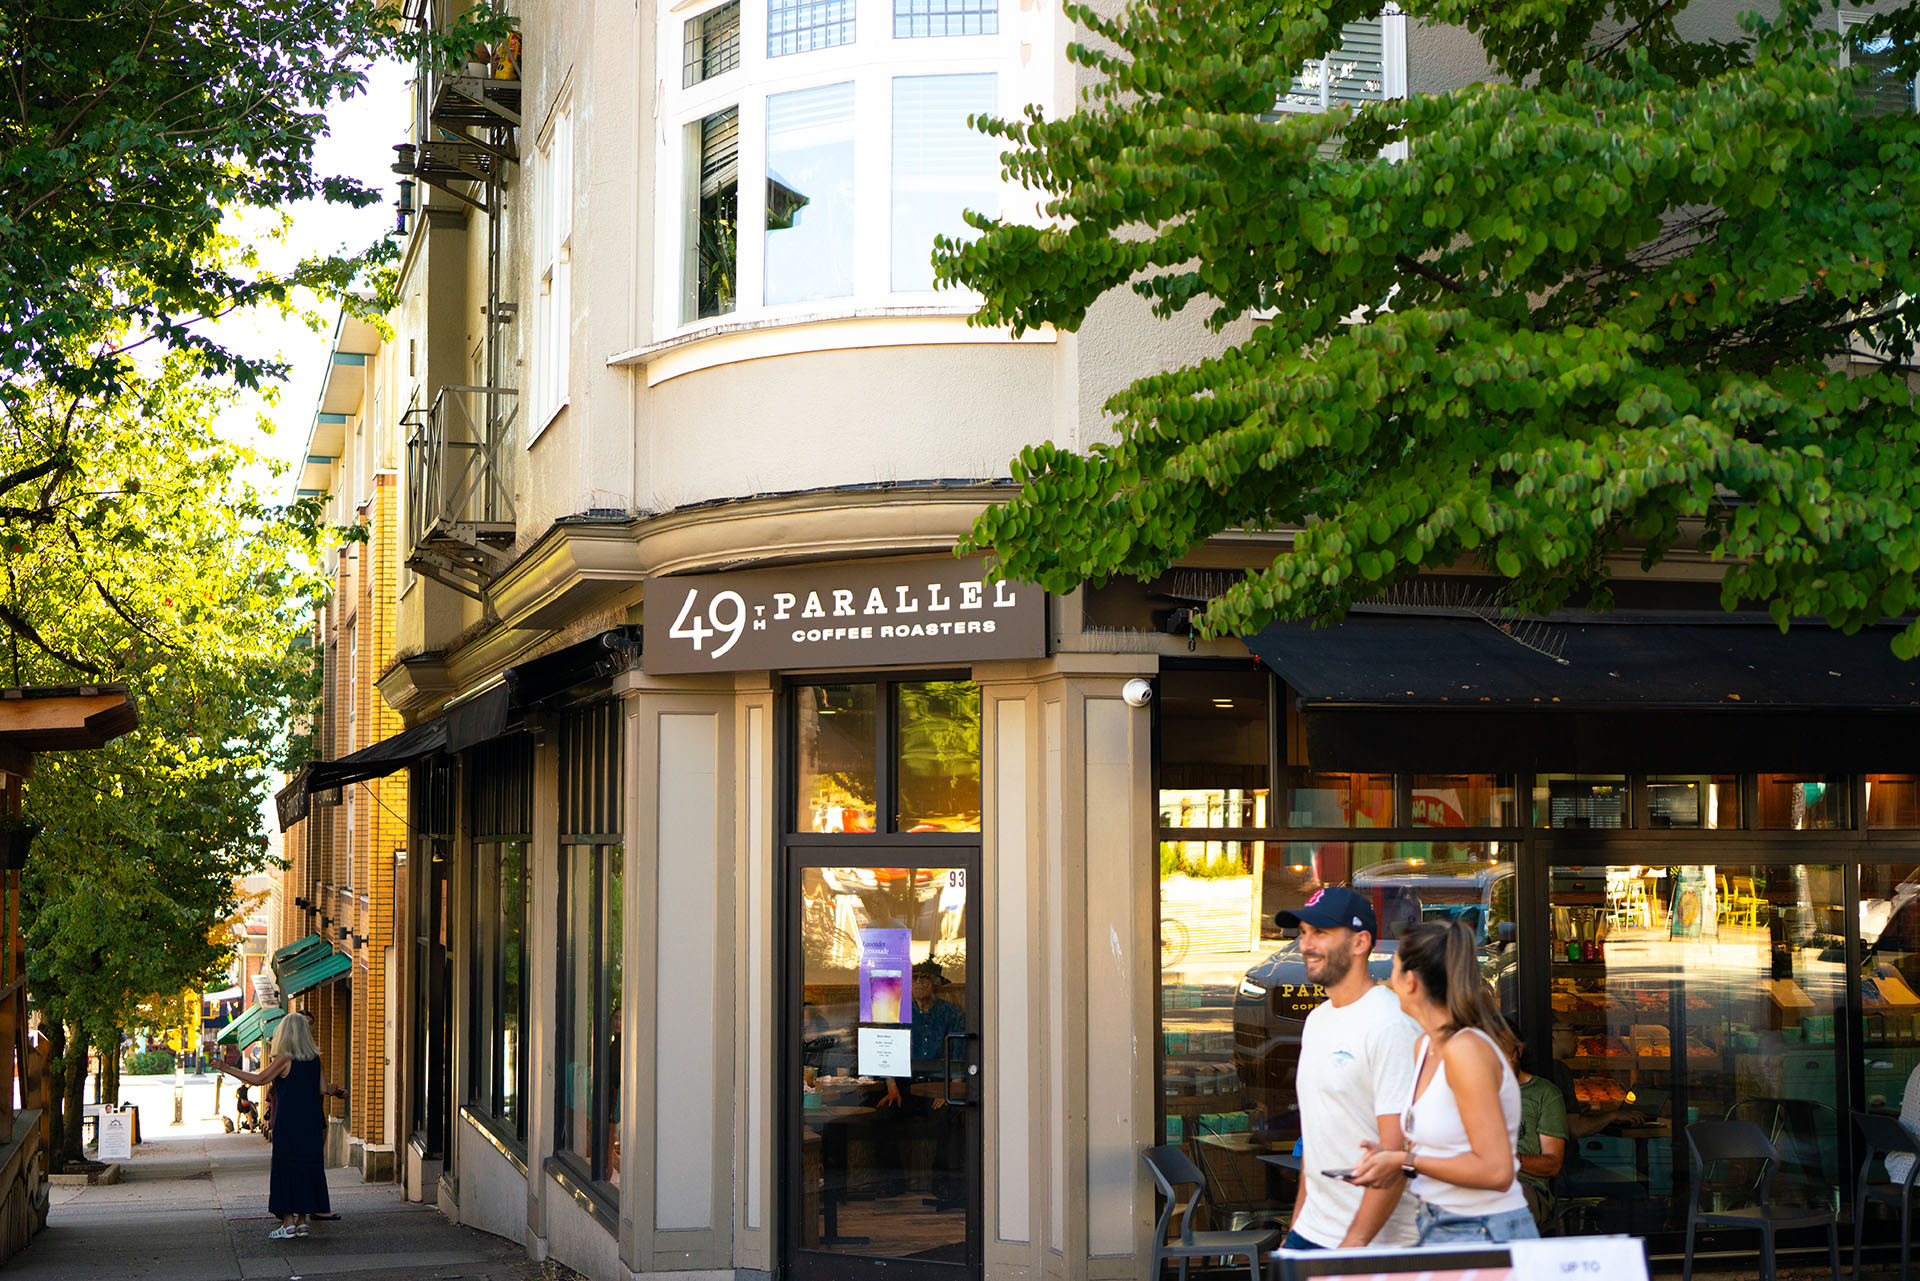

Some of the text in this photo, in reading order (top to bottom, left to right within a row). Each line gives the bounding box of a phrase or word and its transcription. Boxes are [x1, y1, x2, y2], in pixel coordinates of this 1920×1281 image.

[669, 588, 747, 660] 49
[773, 579, 1016, 620] PARALLEL
[791, 620, 996, 643] COFFEE ROASTERS
[949, 870, 965, 888] 93
[1560, 1260, 1601, 1274] UP TO
